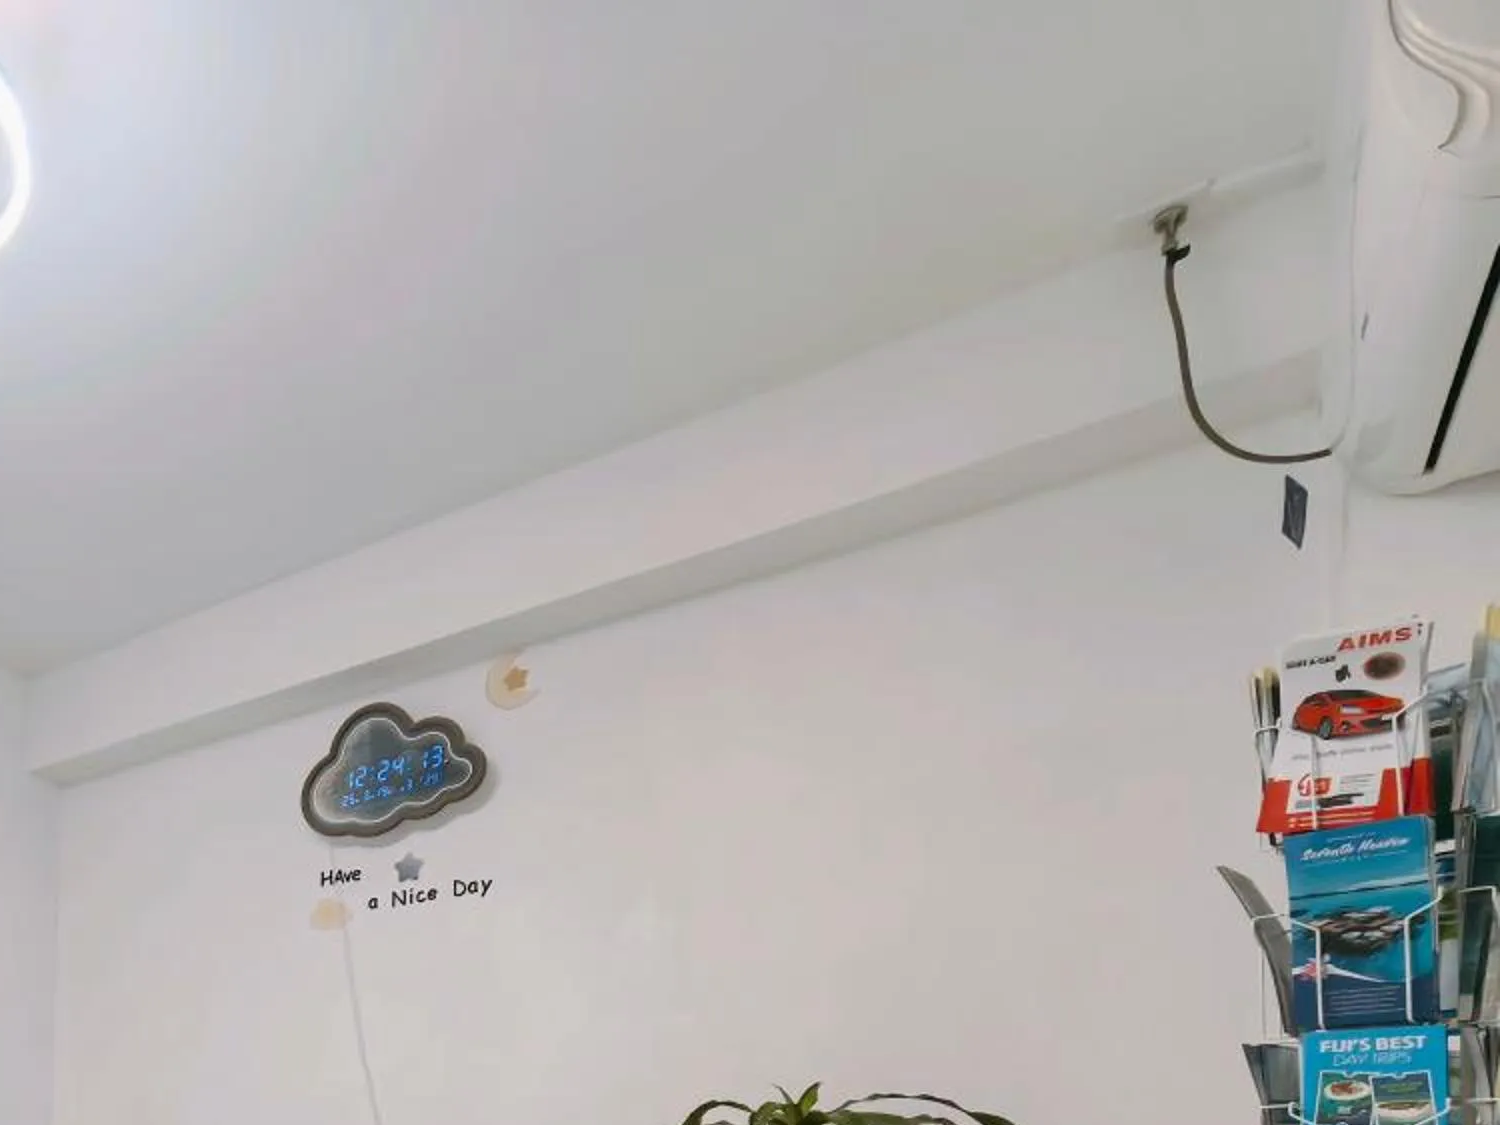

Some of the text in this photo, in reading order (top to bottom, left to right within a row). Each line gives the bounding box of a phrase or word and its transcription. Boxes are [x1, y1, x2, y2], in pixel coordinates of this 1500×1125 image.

[1337, 627, 1412, 651] AIMS
[368, 878, 493, 909] a Nice Day
[1319, 1035, 1427, 1053] FIJI'S BEST
